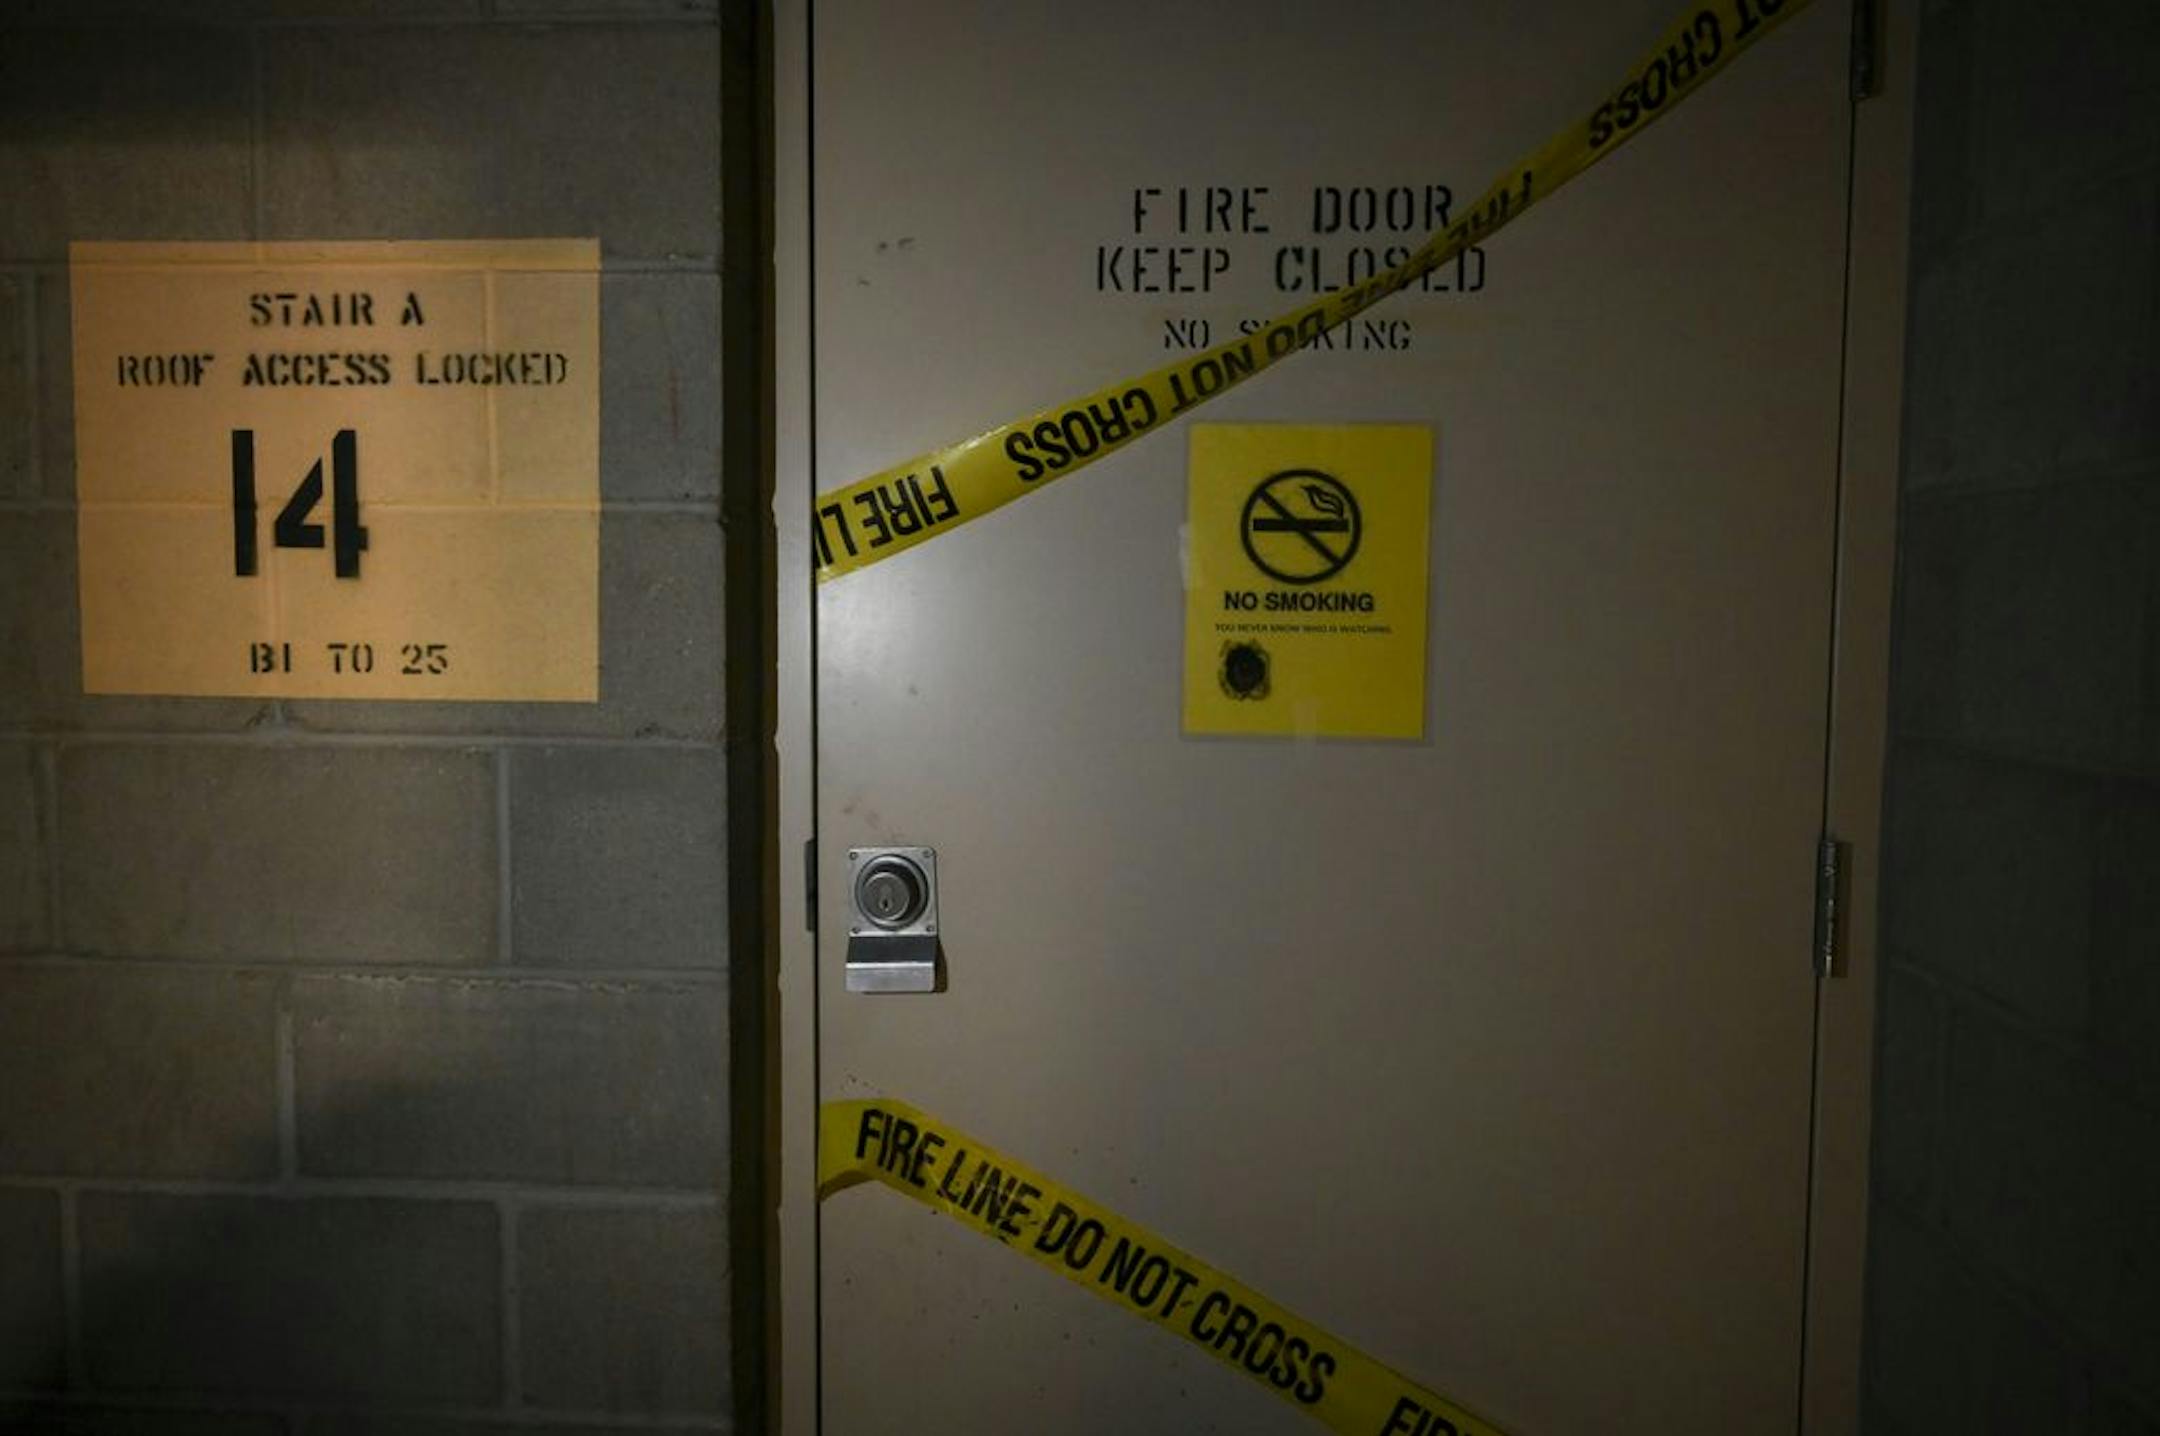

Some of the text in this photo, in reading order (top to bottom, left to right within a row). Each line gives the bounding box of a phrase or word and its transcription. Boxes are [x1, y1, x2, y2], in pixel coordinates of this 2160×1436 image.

[1589, 11, 1722, 148] CROSS
[1135, 185, 1452, 233] FIRE DOOR
[1098, 246, 1230, 292] KEEP
[250, 292, 424, 326] STAIR A
[1165, 320, 1209, 348] NO
[118, 352, 567, 386] ROOF ACCESS LOCKED
[1169, 343, 1256, 413] NOT
[1005, 389, 1158, 482] CROSS
[232, 430, 368, 578] 14
[854, 466, 959, 548] FIRE
[1224, 591, 1374, 612] NO SMOKING
[328, 643, 373, 673] TO
[401, 644, 448, 674] 25
[857, 1109, 946, 1187] FIRE
[937, 1150, 1041, 1236] LINE
[1035, 1201, 1105, 1270] DO
[1099, 1237, 1199, 1317] NOT
[1191, 1291, 1335, 1403] CROSS
